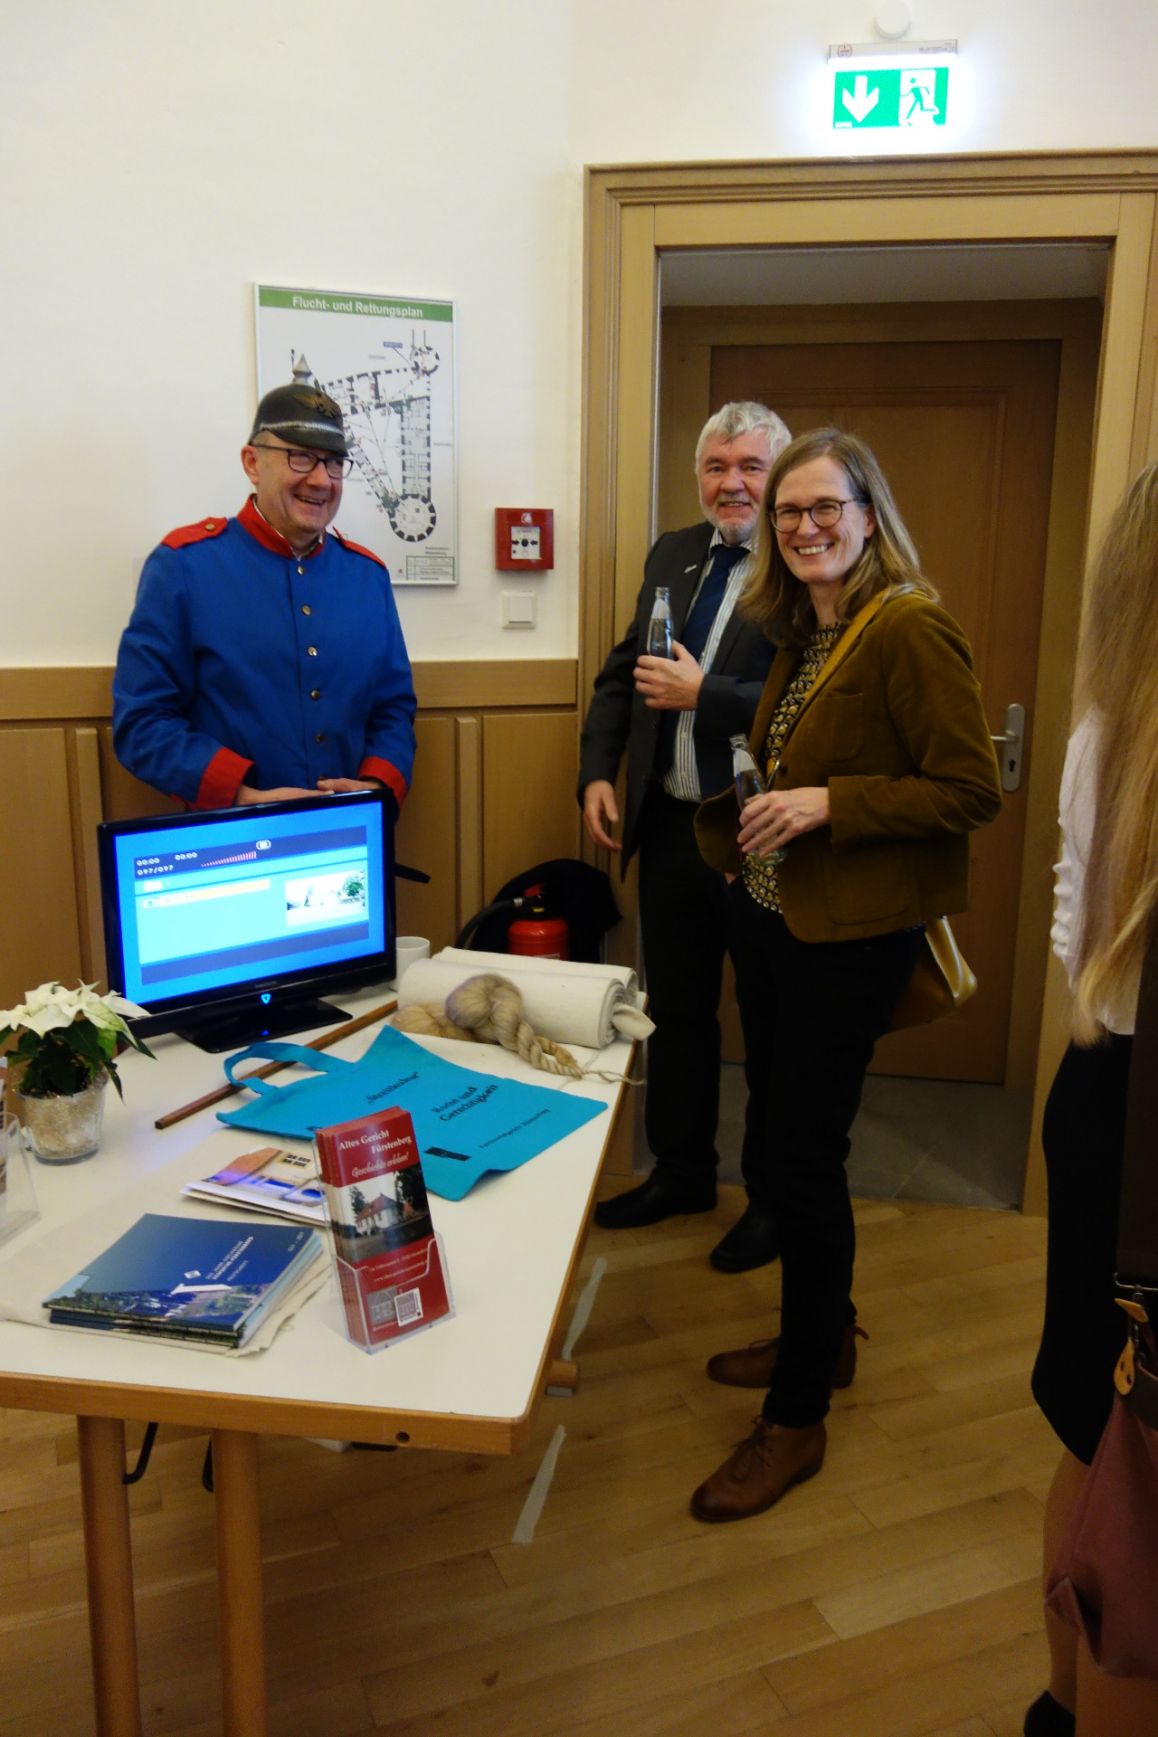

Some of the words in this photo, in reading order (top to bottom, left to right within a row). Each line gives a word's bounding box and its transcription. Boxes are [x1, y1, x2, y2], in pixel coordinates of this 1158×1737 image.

[292, 296, 331, 310] Flucht-
[332, 301, 353, 312] und
[355, 303, 424, 318] Rettungsplan
[338, 1136, 360, 1151] Altes
[360, 1130, 390, 1146] Gericht
[371, 1135, 413, 1154] Fürstenberg
